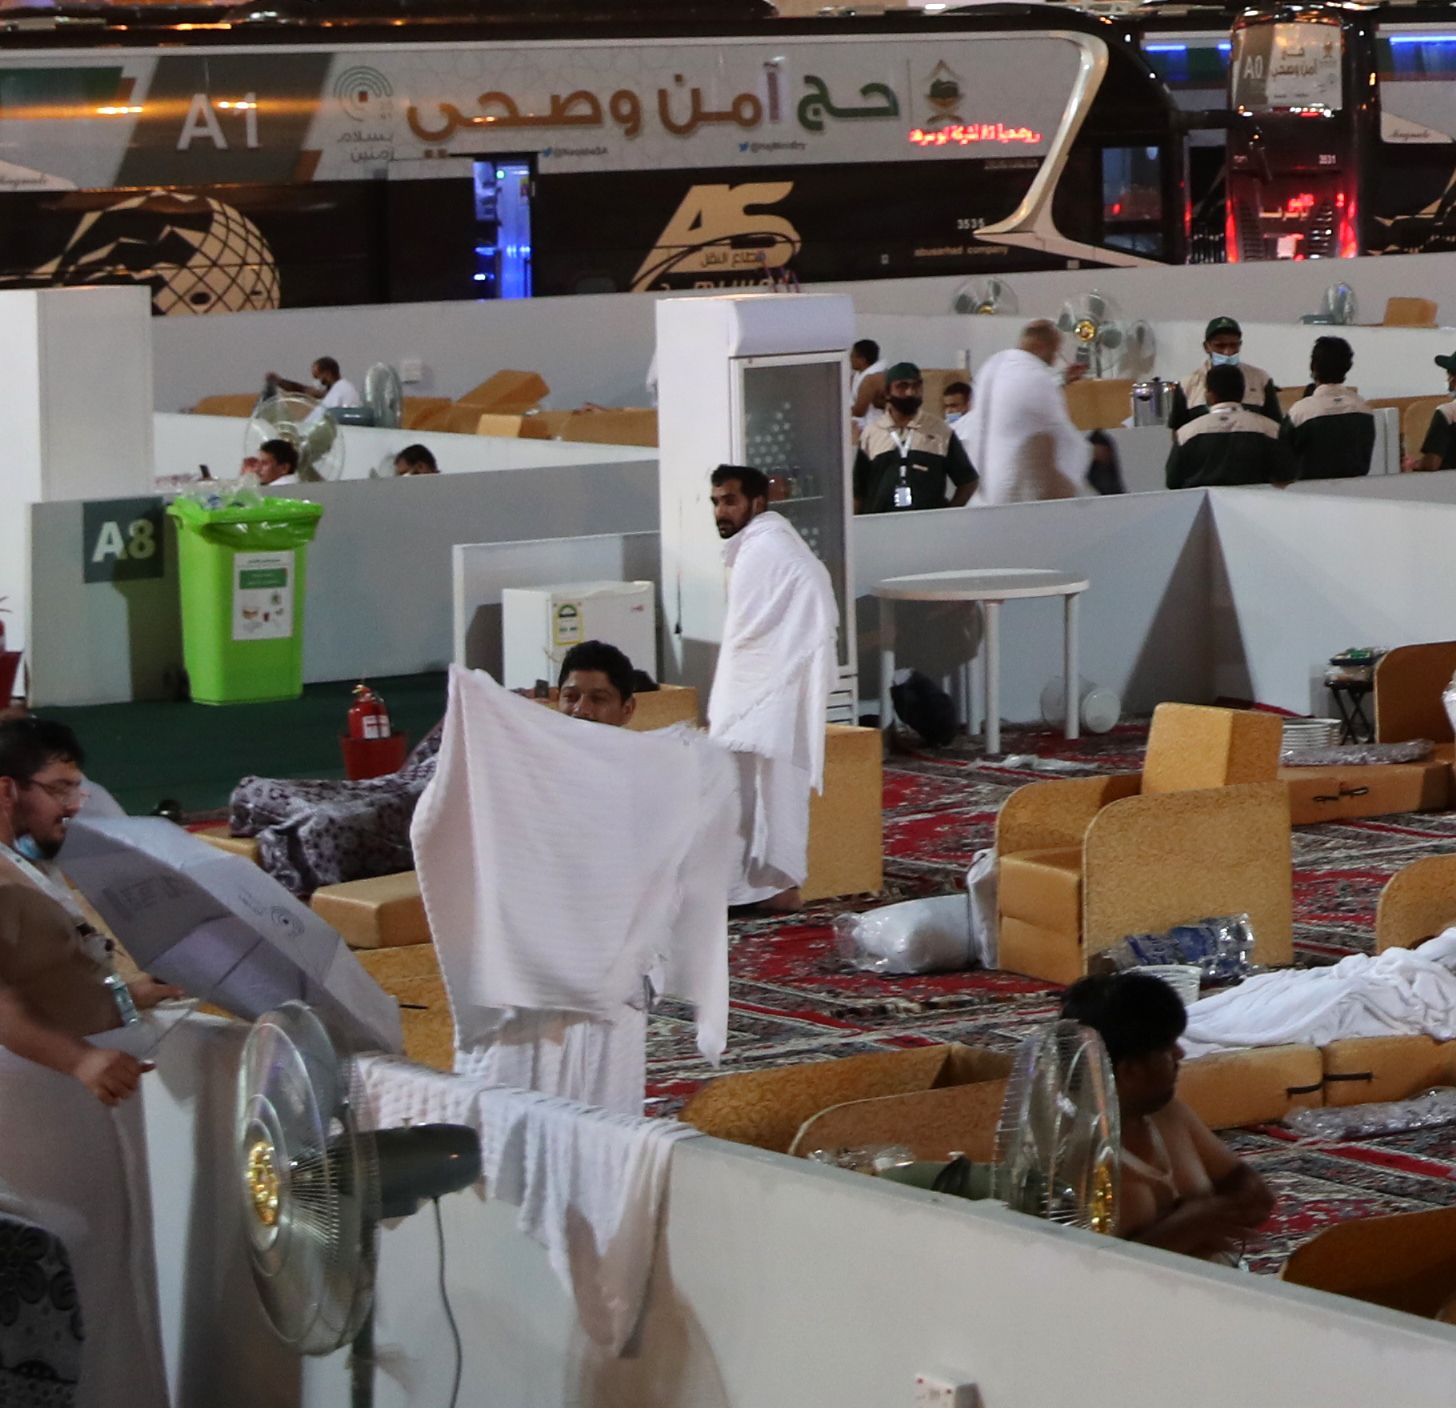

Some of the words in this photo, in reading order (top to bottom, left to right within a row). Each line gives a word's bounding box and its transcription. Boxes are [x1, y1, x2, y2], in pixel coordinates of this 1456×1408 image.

[1243, 54, 1264, 79] A0
[406, 88, 643, 142] وصحي
[797, 74, 900, 132] حج
[177, 93, 261, 151] A1
[957, 217, 986, 230] 3535
[732, 250, 766, 268] طاع
[967, 245, 1009, 256] company
[91, 518, 155, 563] A8
